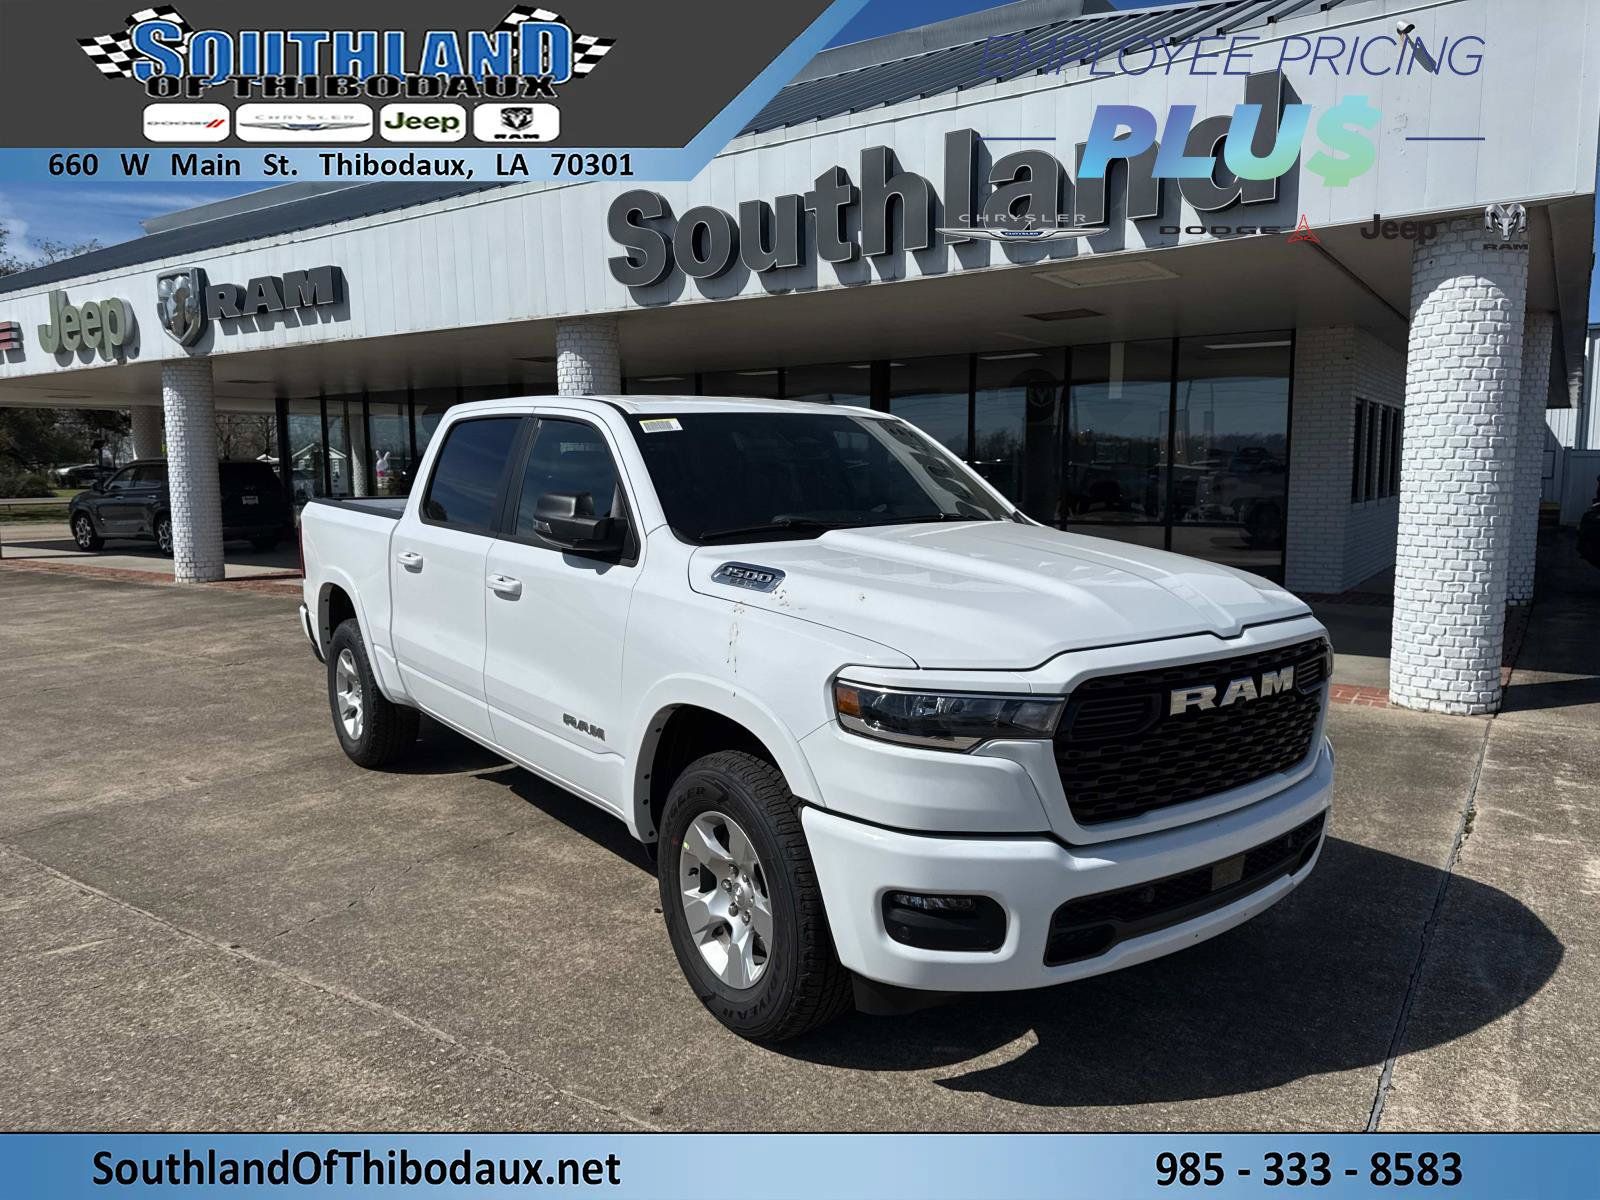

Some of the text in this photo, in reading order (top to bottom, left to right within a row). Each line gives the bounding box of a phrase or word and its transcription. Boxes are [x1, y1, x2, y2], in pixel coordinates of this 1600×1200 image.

[607, 70, 1298, 290] Southland
[206, 265, 341, 320] RAM
[38, 290, 134, 361] Jeep
[722, 565, 775, 583] 1500
[1169, 665, 1295, 717] RAM
[562, 712, 606, 742] RAM
